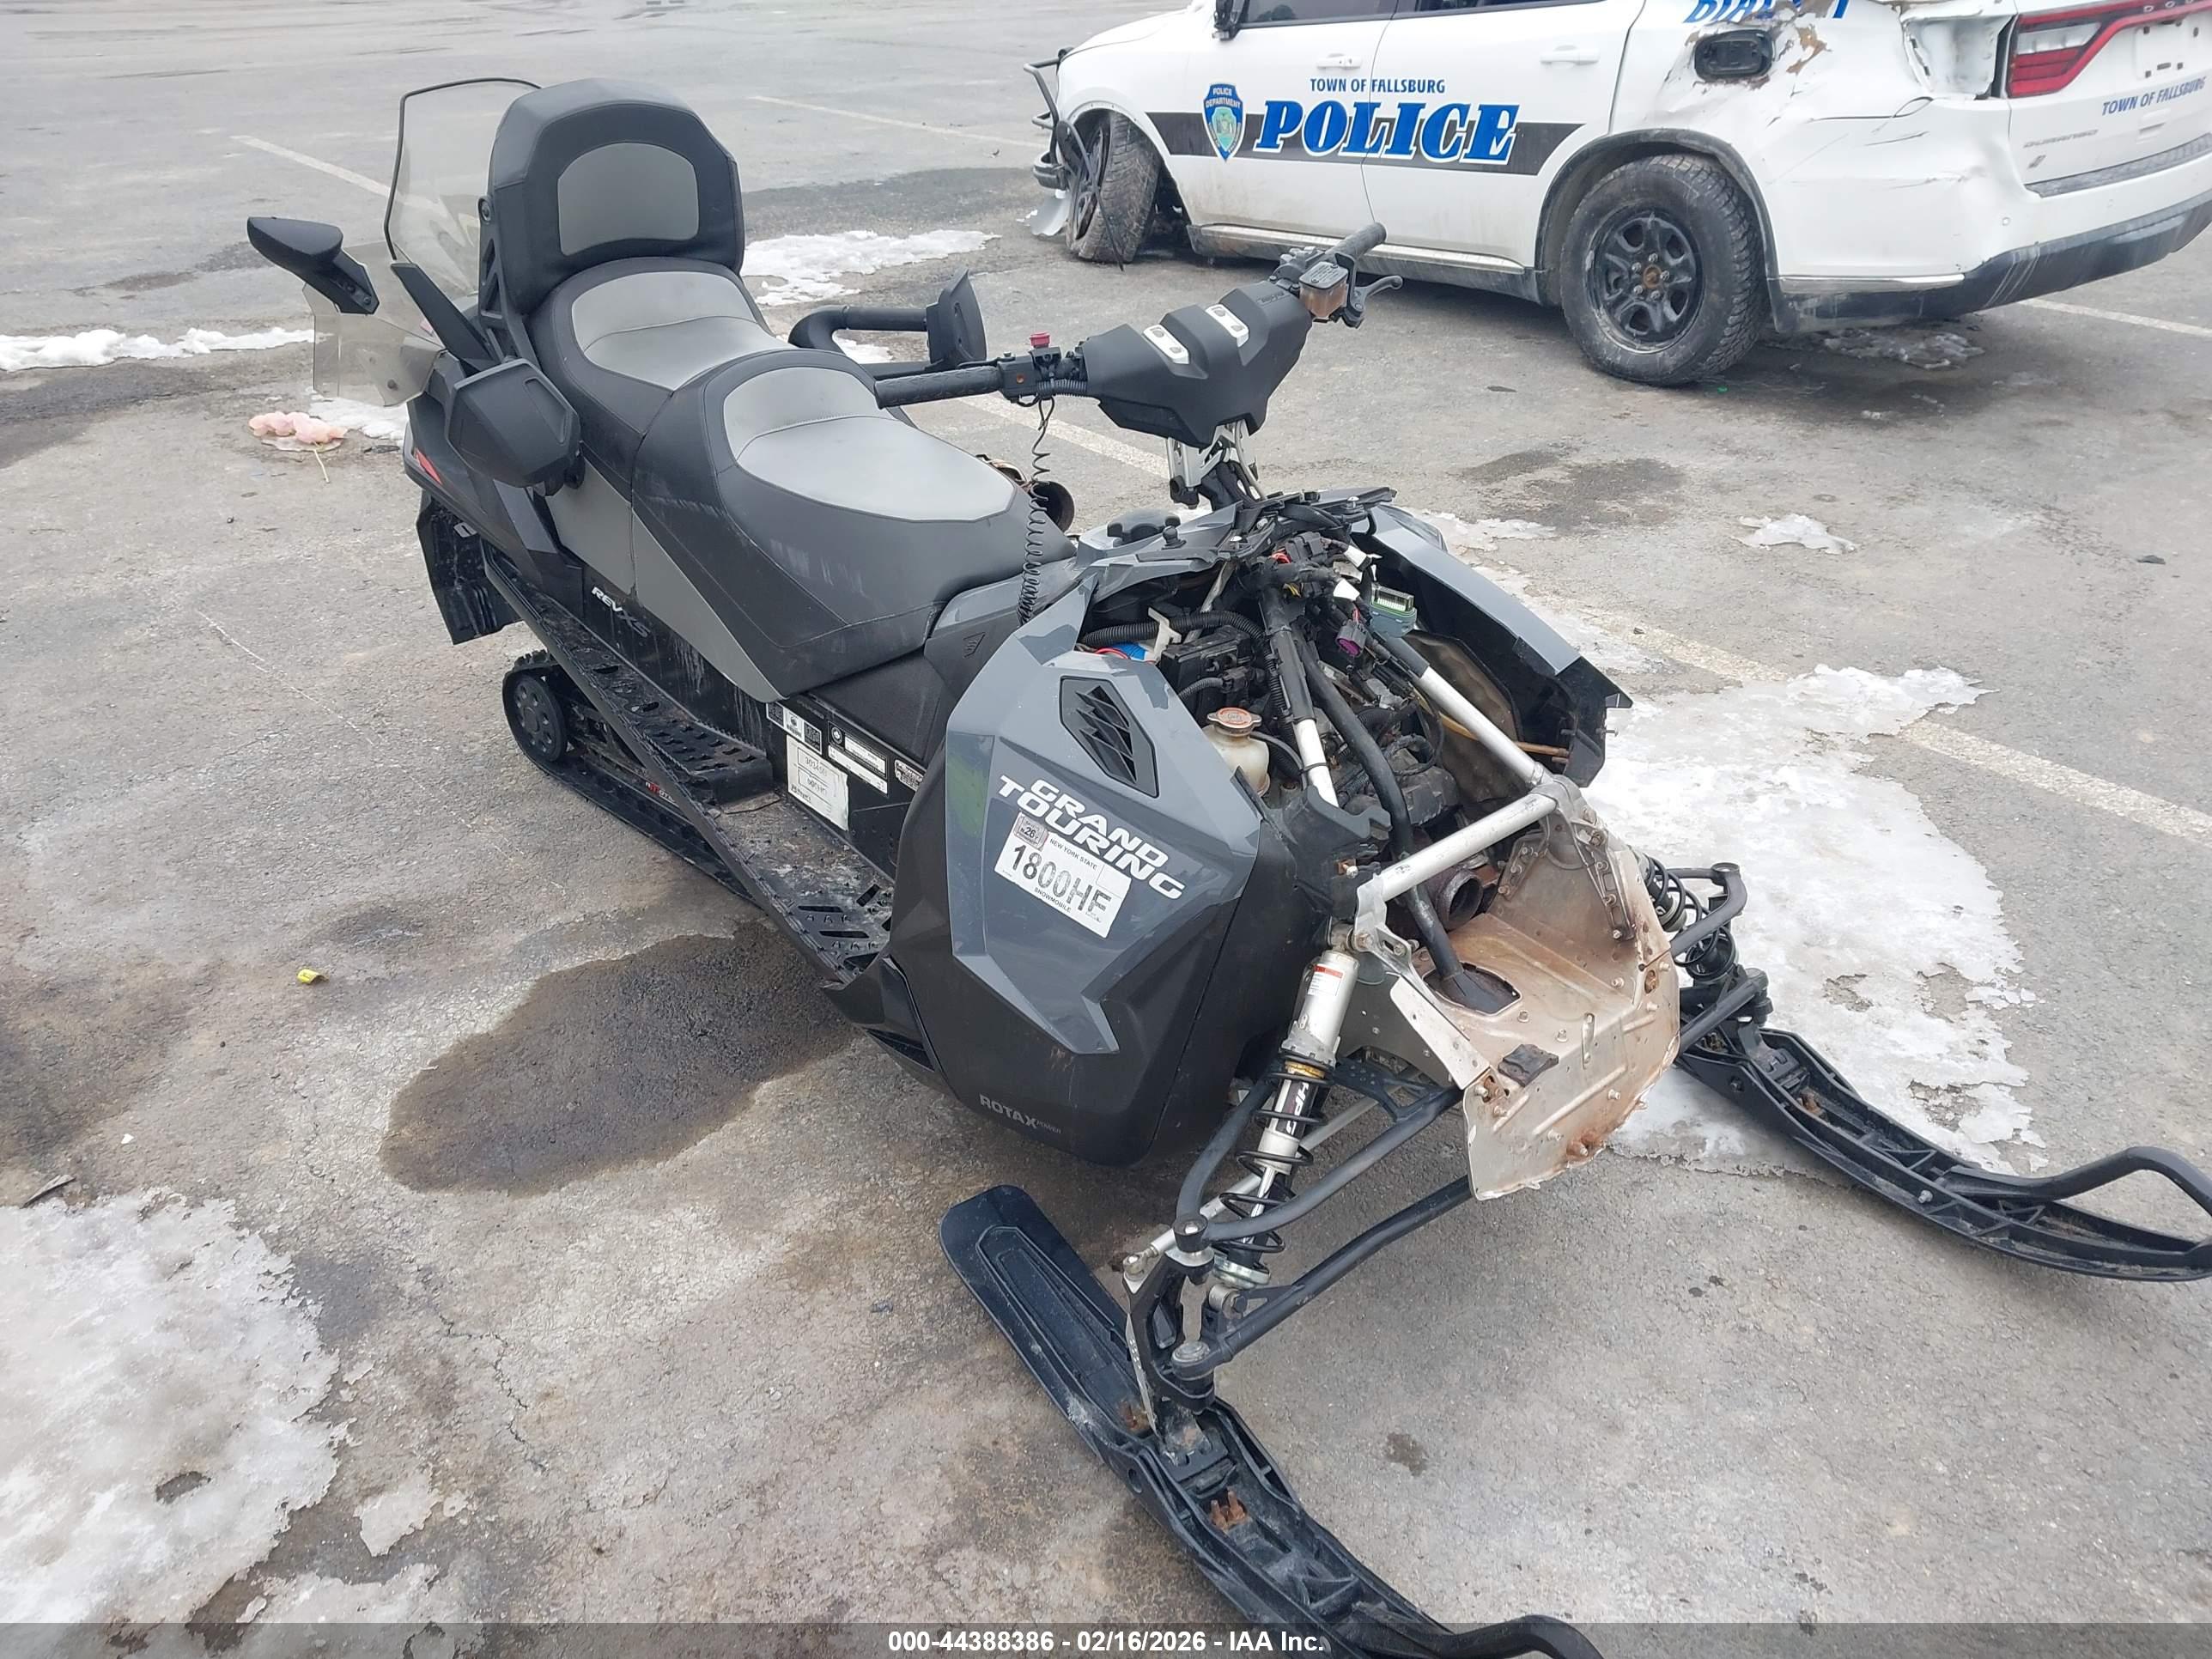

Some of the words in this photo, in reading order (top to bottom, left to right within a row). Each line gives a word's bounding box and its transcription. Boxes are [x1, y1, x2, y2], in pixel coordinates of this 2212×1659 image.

[1310, 78, 1346, 92] TOWN
[1351, 78, 1367, 93] OF
[1371, 79, 1446, 94] FALLSBURG
[2102, 96, 2137, 116] TOWN
[2140, 91, 2154, 107] OF
[2156, 76, 2207, 104] FALLSBURG
[1254, 100, 1520, 164] POLICE
[592, 586, 623, 611] REV
[999, 775, 1186, 900] TOURING
[1024, 826, 1035, 838] 26
[1030, 779, 1169, 867] GRAND
[1049, 838, 1064, 850] NEW
[1063, 845, 1079, 860] YORK
[1079, 854, 1097, 871] STATE
[1034, 887, 1073, 913] SNOWMOBILE
[979, 1092, 1037, 1129] ROTAX
